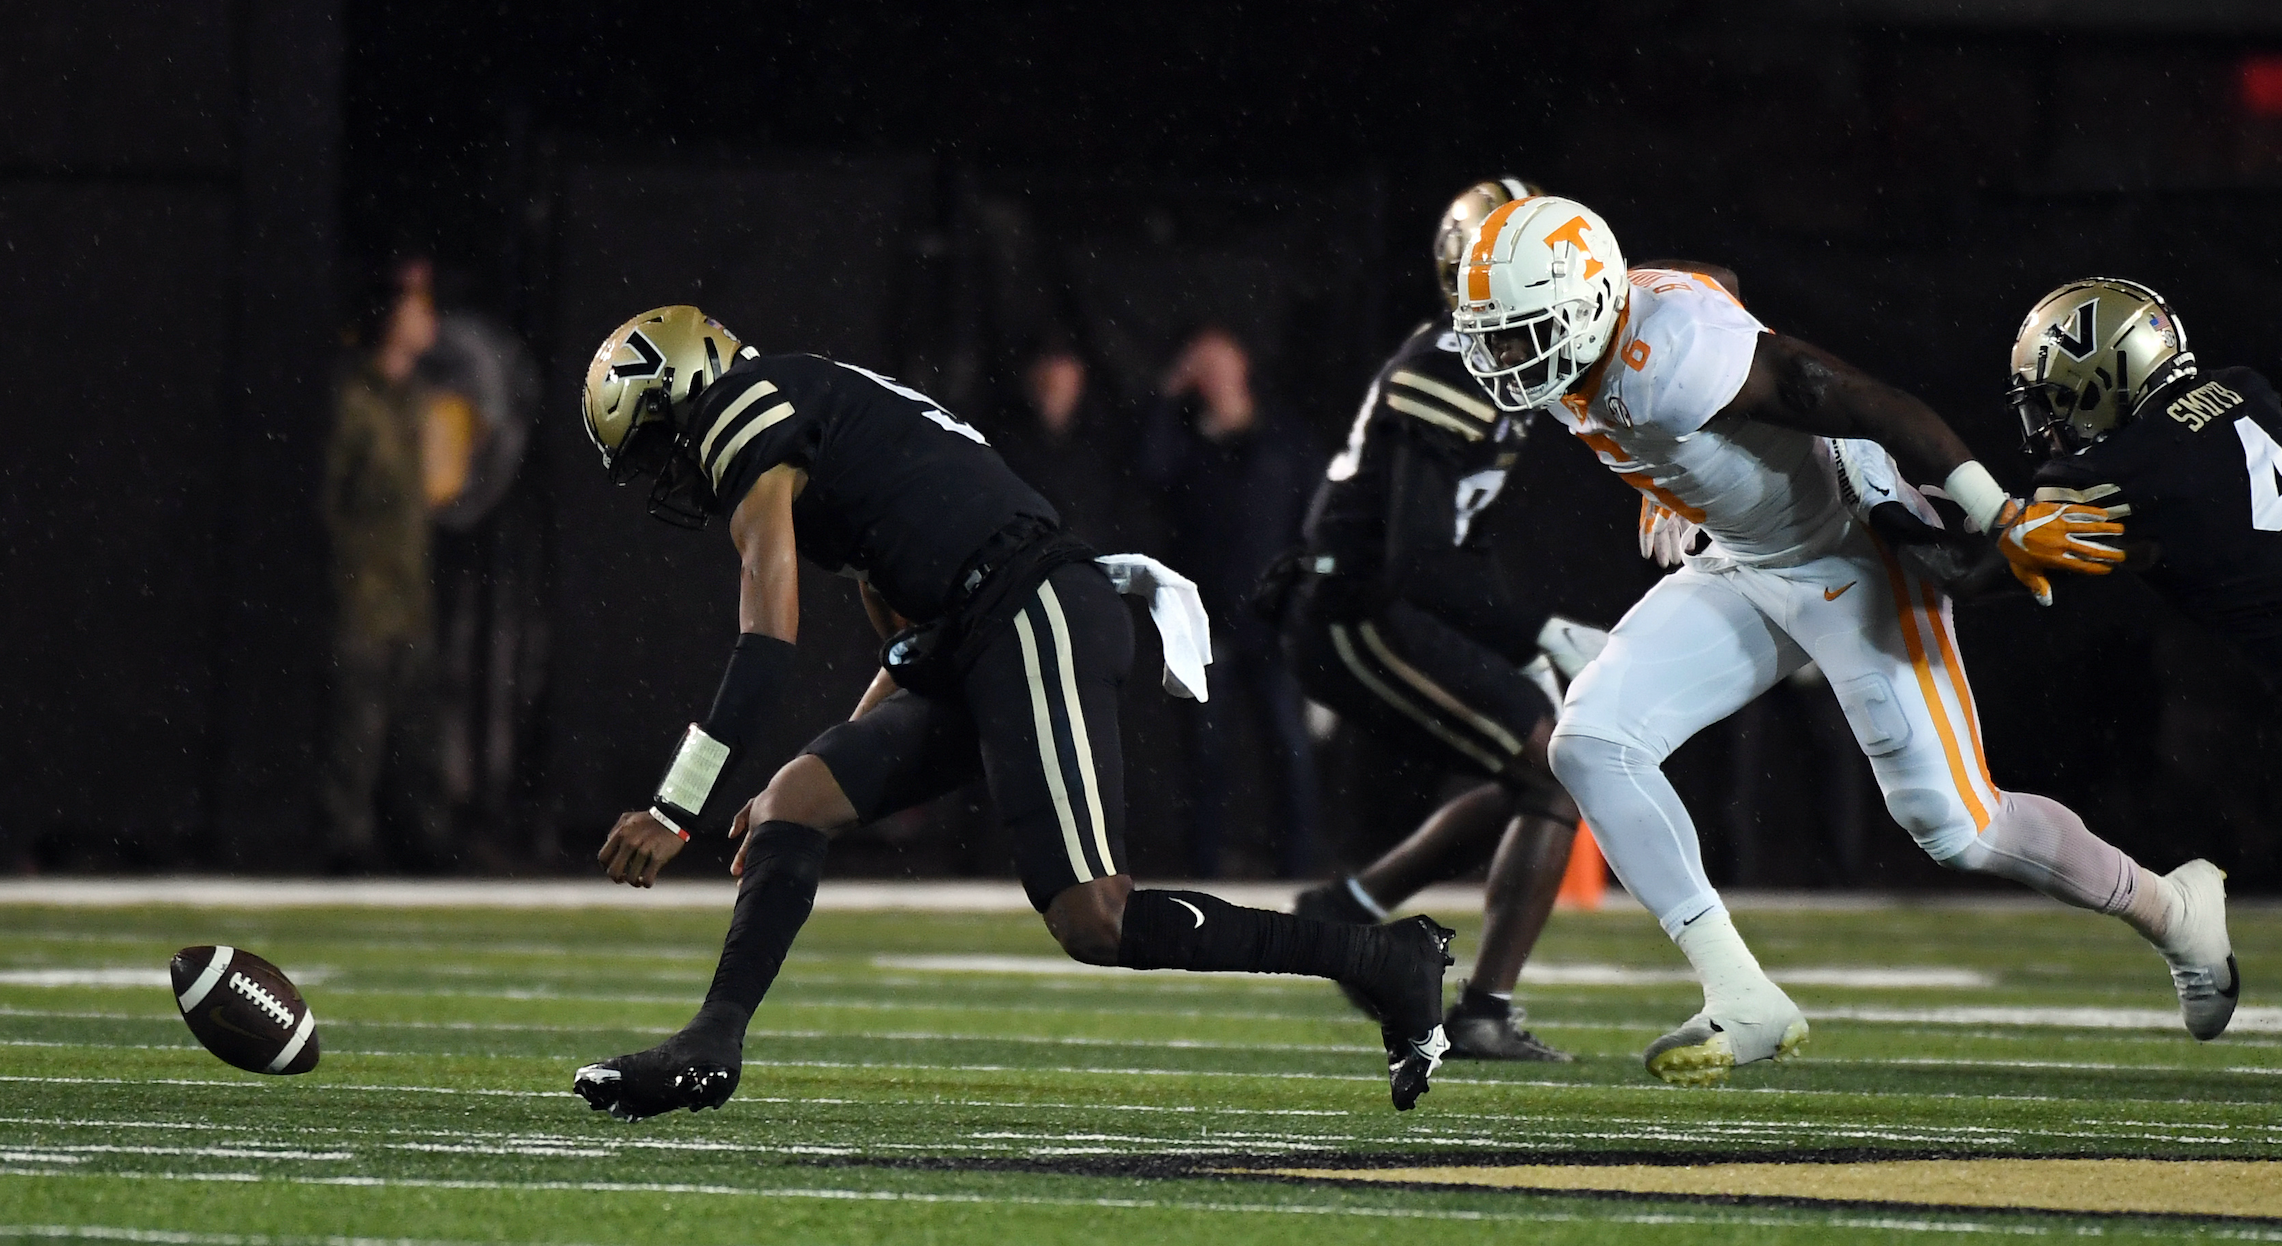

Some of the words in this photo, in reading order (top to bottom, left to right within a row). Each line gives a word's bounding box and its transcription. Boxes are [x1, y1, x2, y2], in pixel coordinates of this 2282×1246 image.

[1543, 215, 1605, 281] T
[602, 326, 667, 387] V
[1620, 339, 1651, 373] 6
[2041, 298, 2099, 363] V
[2167, 381, 2244, 433] SMITH
